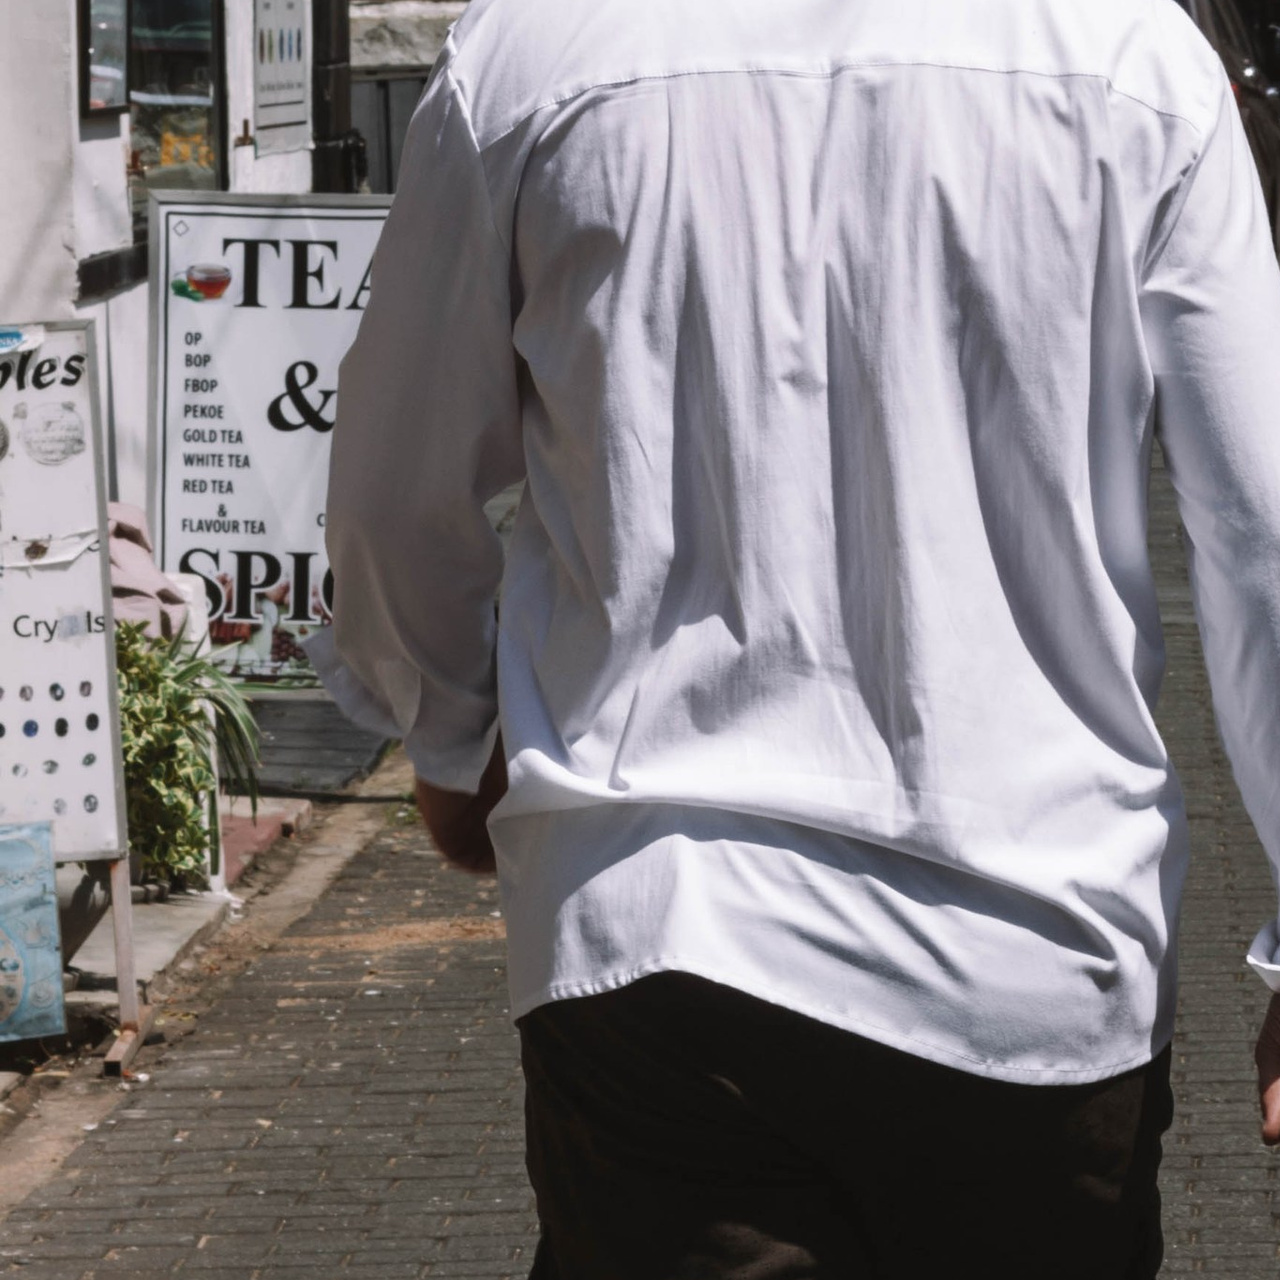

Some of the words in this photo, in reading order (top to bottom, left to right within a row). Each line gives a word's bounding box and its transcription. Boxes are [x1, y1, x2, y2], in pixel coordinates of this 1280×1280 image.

[184, 331, 202, 346] OP
[184, 353, 211, 368] BOP
[184, 378, 218, 393] FBOP
[267, 360, 338, 433] &
[183, 404, 224, 419] PEKOE
[182, 428, 218, 443] GOLD
[220, 429, 244, 444] TEA
[183, 453, 225, 468] WHITE
[227, 454, 251, 469] TEA
[182, 479, 208, 494] RED
[210, 480, 235, 494] TEA
[217, 503, 227, 518] &
[181, 518, 240, 534] FLAVOUR
[243, 519, 266, 535] TEA
[179, 548, 334, 621] SPI
